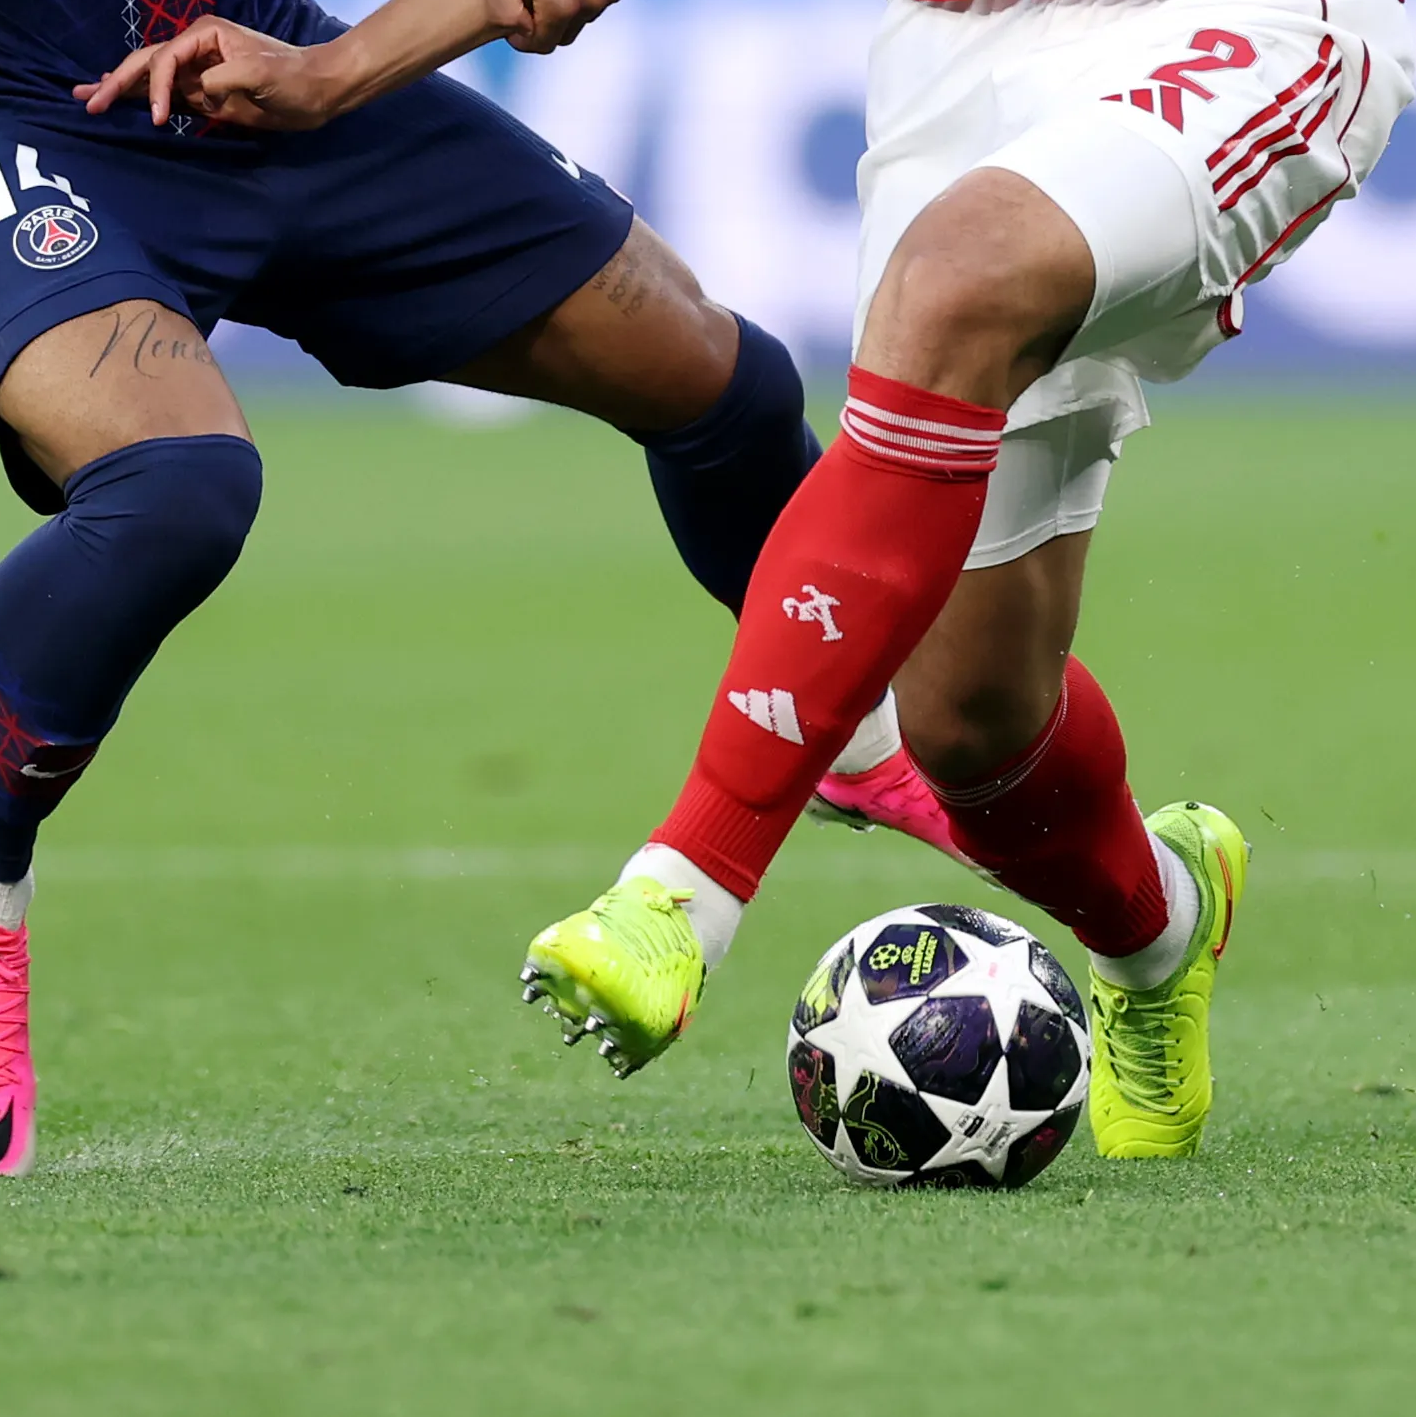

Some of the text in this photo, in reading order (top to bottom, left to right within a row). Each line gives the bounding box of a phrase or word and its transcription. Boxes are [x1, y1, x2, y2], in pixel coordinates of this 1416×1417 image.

[1143, 27, 1260, 103] 2
[20, 207, 75, 232] PARIS
[910, 931, 931, 985] CHAMPIONS
[921, 937, 938, 974] LEAGUE
